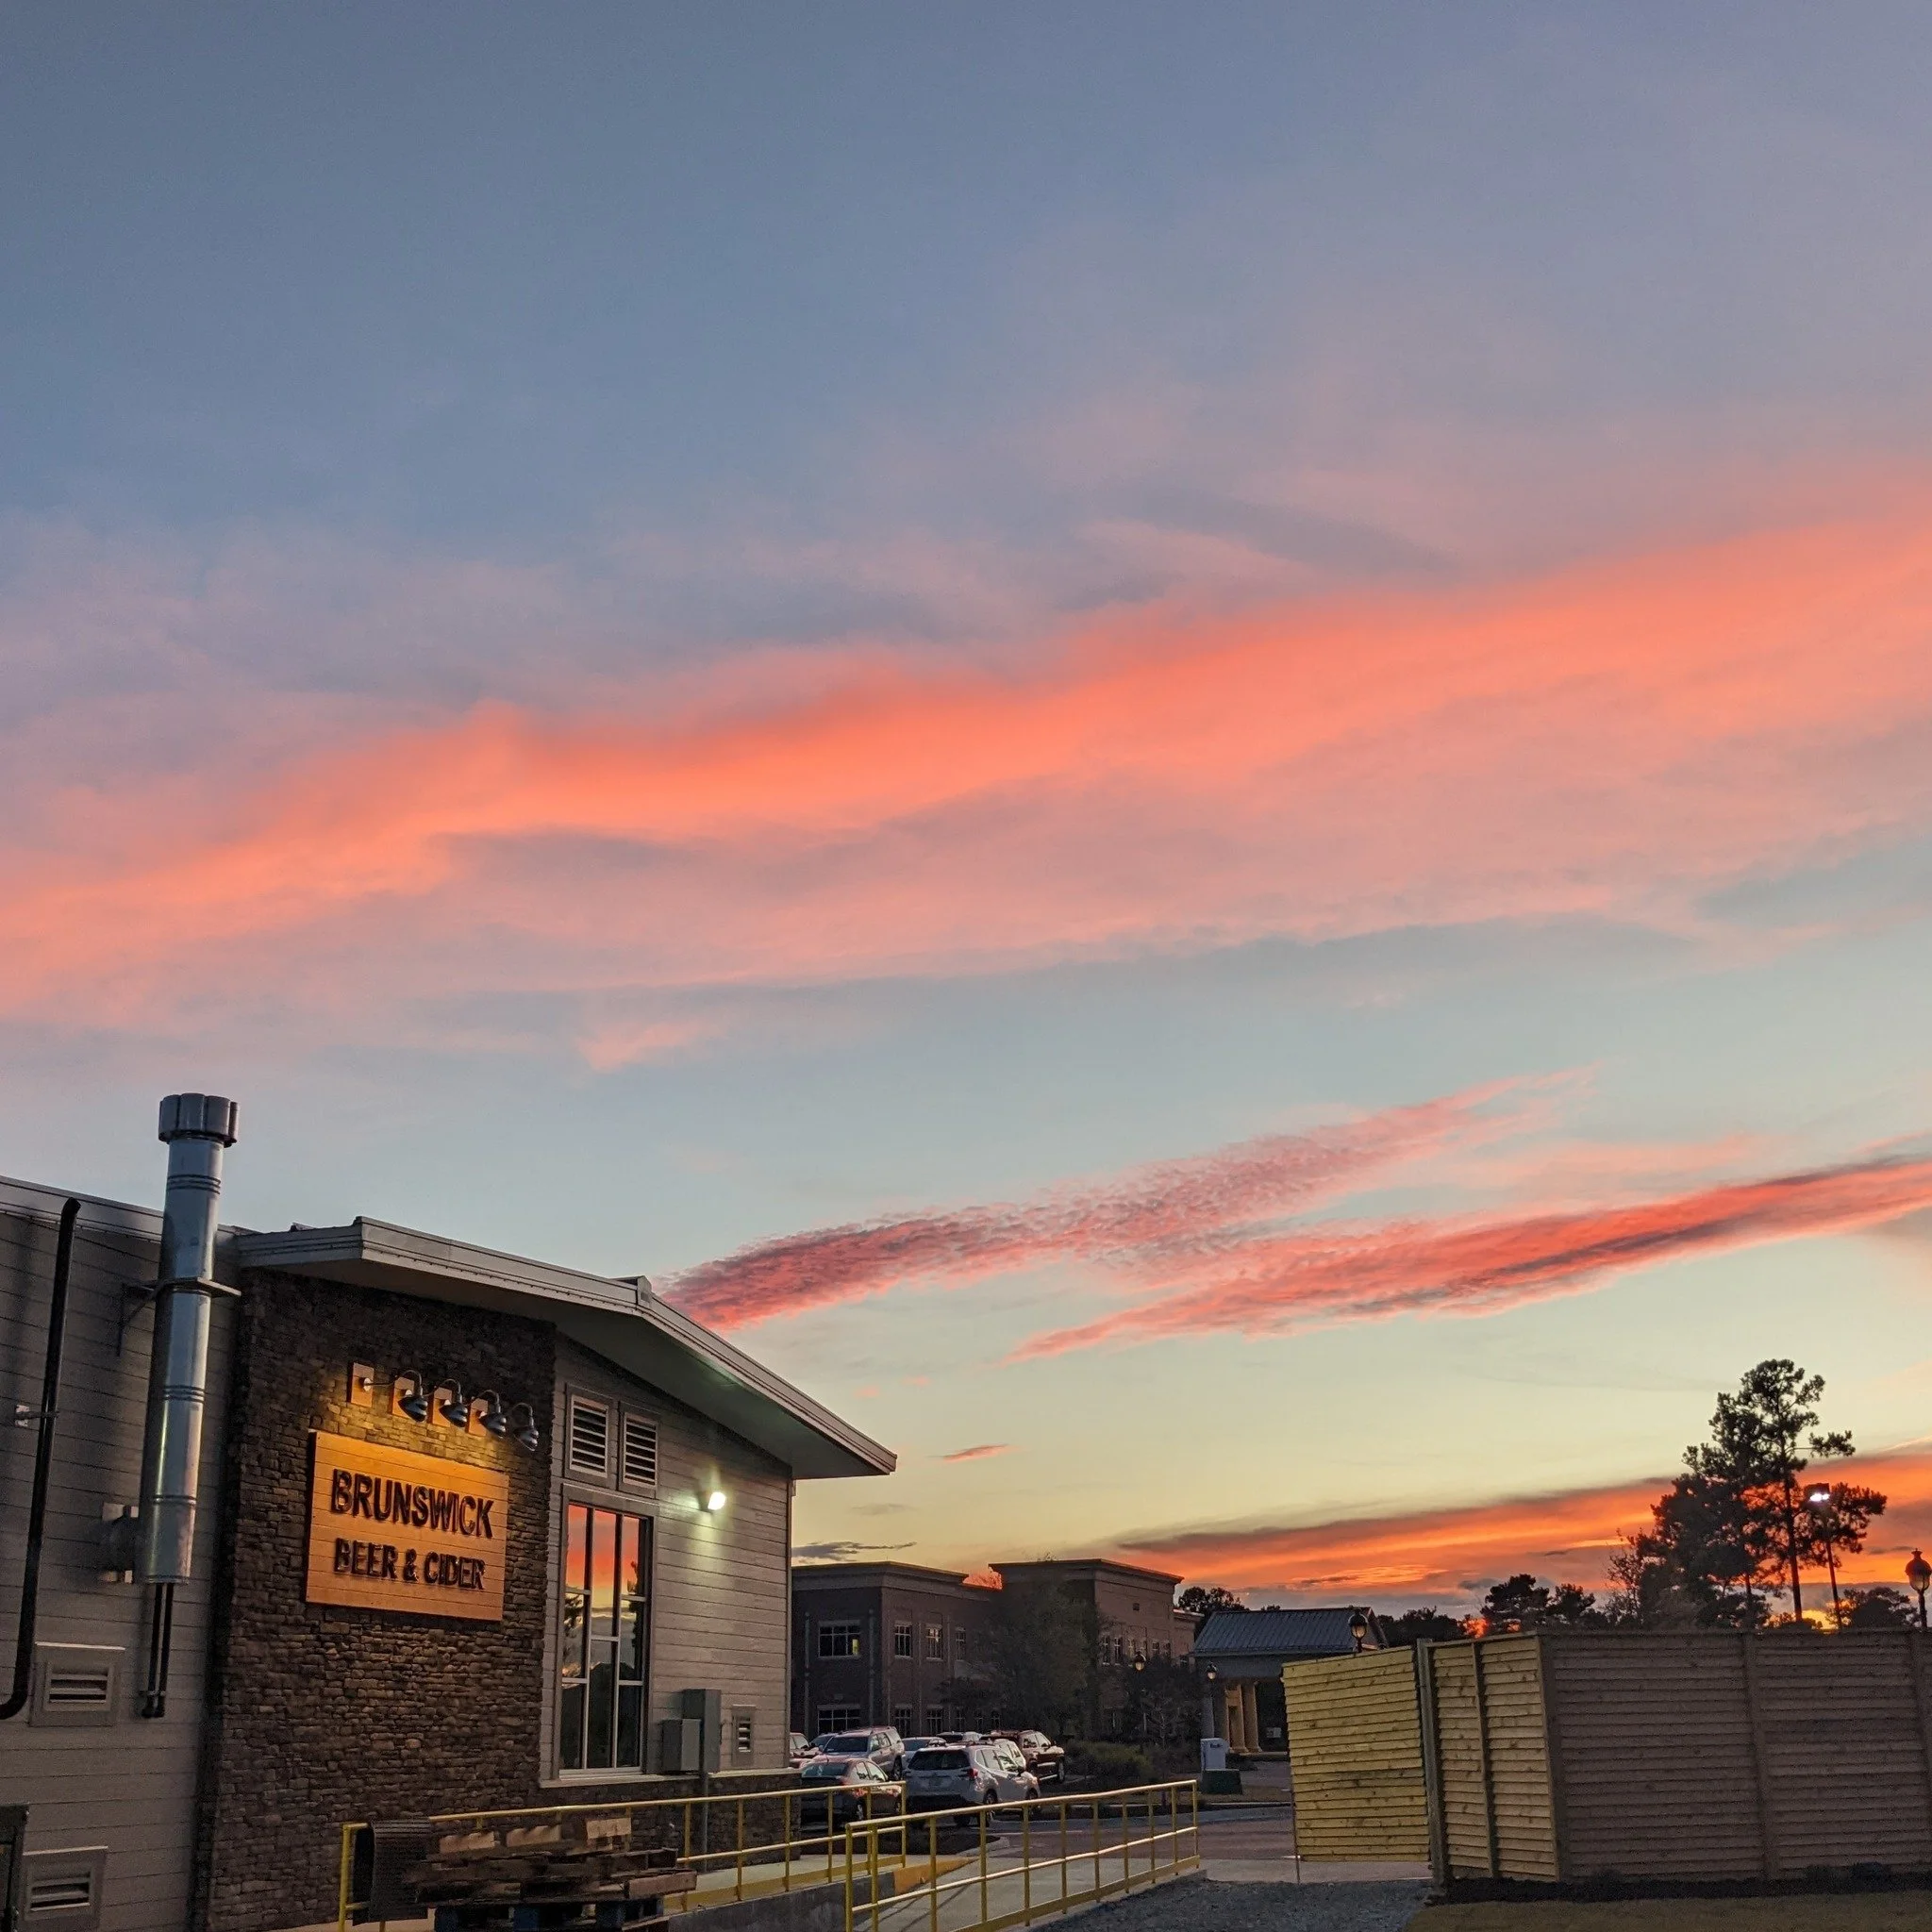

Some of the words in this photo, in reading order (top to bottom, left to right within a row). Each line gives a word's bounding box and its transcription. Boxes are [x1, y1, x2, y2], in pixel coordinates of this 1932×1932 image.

[332, 1469, 493, 1539] BRUNSWICK
[335, 1539, 398, 1579] BEER
[404, 1548, 420, 1582] &
[425, 1552, 486, 1591] CIDER
